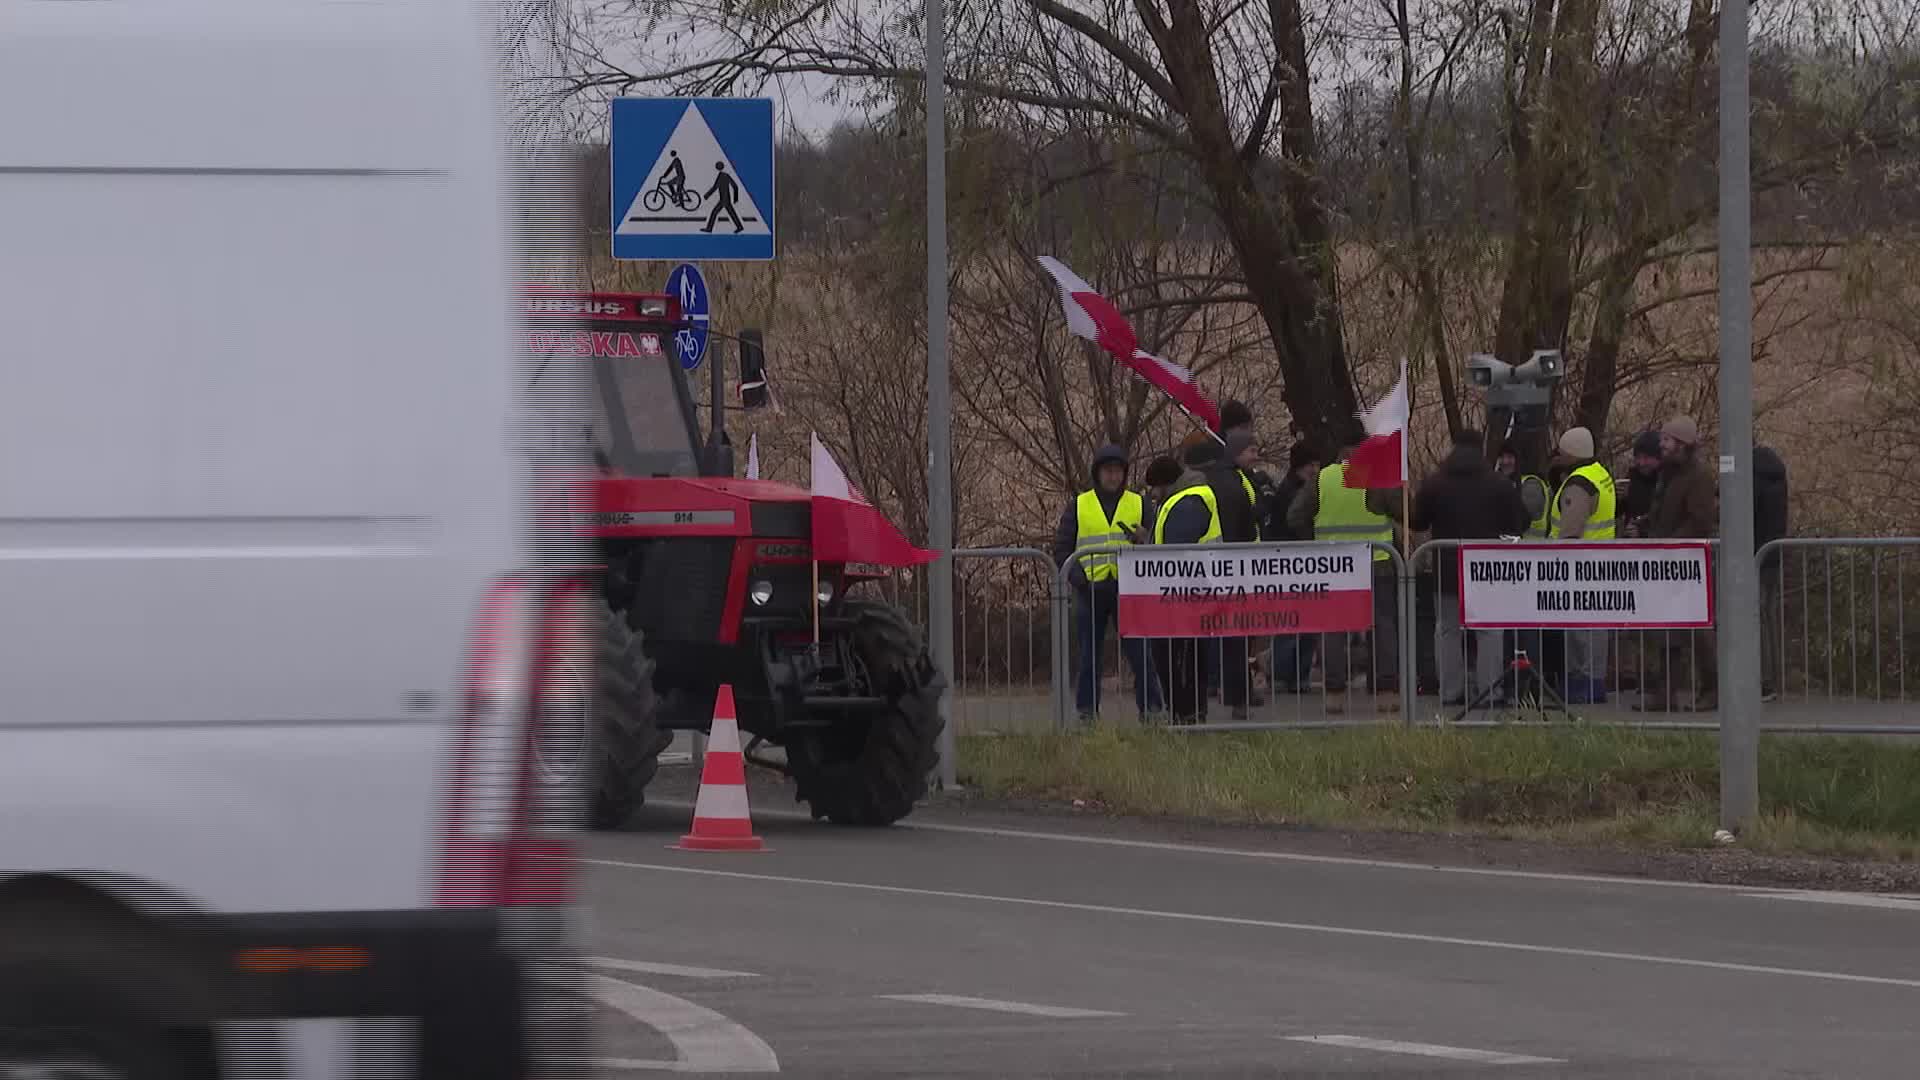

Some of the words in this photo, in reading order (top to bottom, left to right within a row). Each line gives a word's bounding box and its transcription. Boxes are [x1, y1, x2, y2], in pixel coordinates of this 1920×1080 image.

[674, 512, 694, 523] 914
[1134, 559, 1207, 578] UMOWA
[1211, 559, 1234, 577] UE
[1239, 559, 1245, 577] I
[1251, 556, 1354, 576] MERCOSUR
[1469, 560, 1532, 585] RZĄDZĄCY
[1537, 557, 1570, 582] DUŻO
[1574, 559, 1639, 582] ROLNIKOM
[1641, 558, 1702, 584] OBIECUJĄ
[1253, 582, 1330, 601] POLSKIE
[1536, 590, 1571, 612] MAŁO
[1573, 590, 1636, 614] REALIZUJĄ
[1200, 611, 1299, 631] ROLNICTWO
